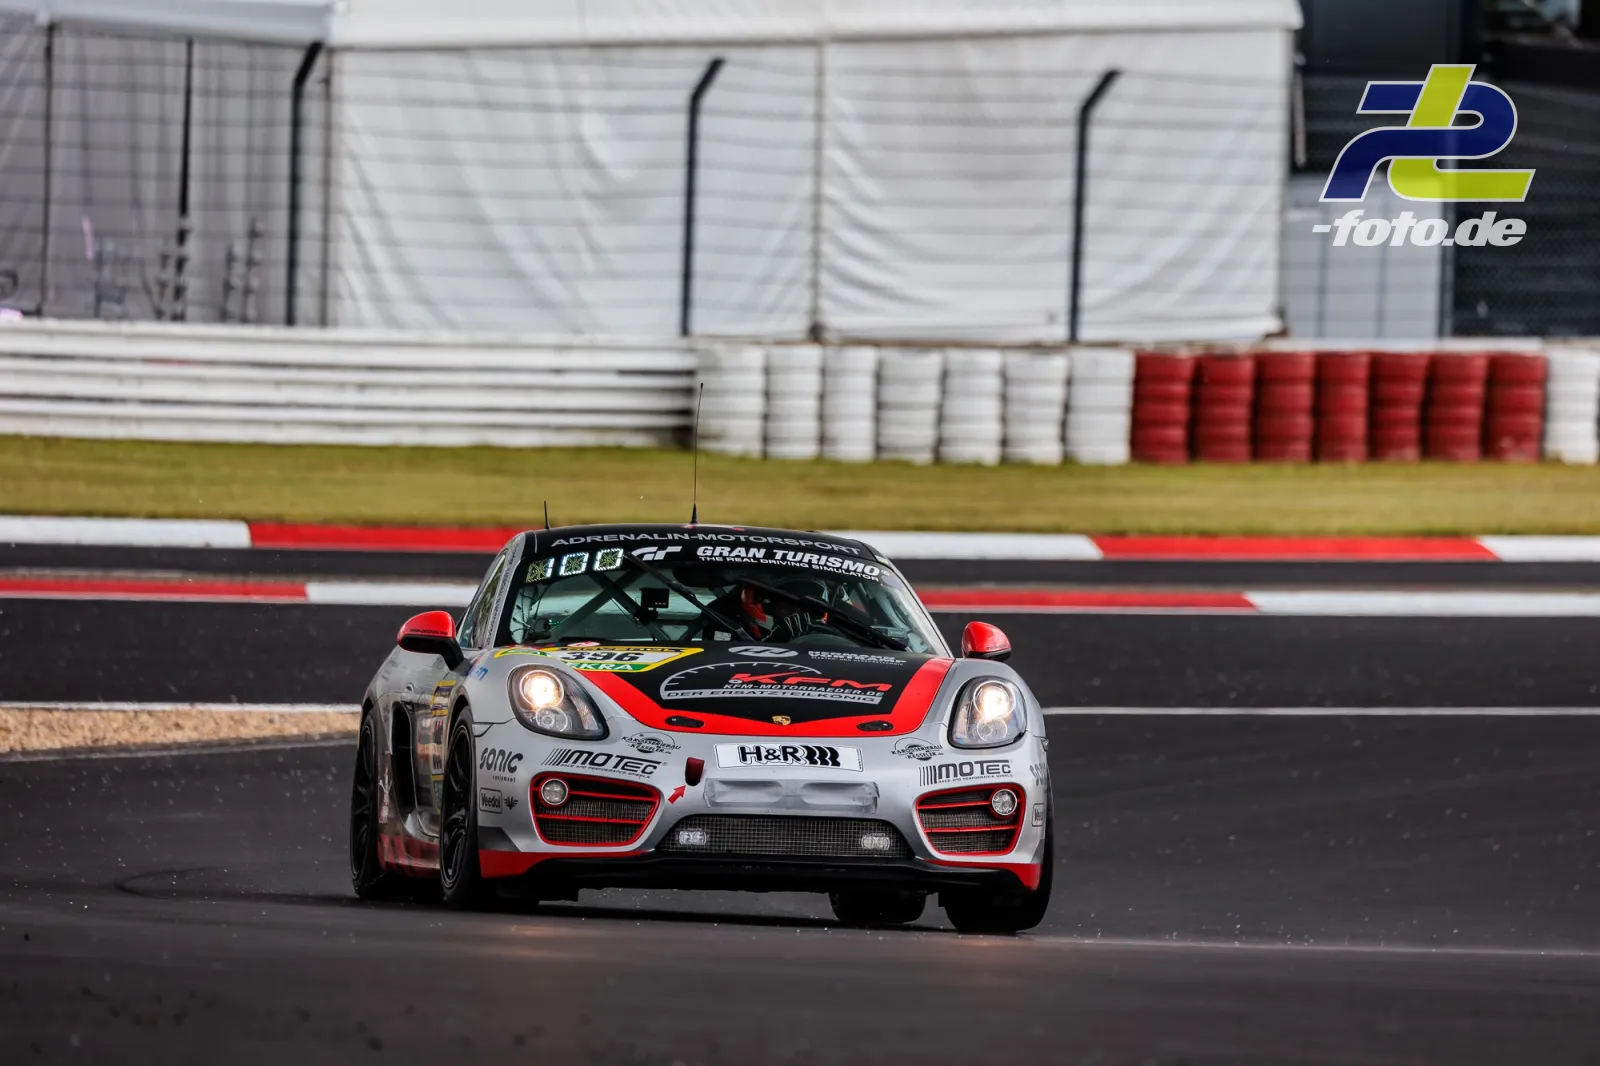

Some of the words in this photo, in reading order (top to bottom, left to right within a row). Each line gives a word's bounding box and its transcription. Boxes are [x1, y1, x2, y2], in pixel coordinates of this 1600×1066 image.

[551, 533, 861, 555] ADRENALIN-MOTORSPORT
[696, 546, 766, 558] GRAN
[773, 549, 881, 577] TURISMO
[760, 558, 809, 568] DRIVING
[811, 564, 880, 582] SIMULATOR
[560, 651, 645, 662] 396
[723, 683, 885, 698] KFM-MOTORRAEDER.DE
[732, 671, 893, 692] KFM
[738, 745, 803, 763] H&R
